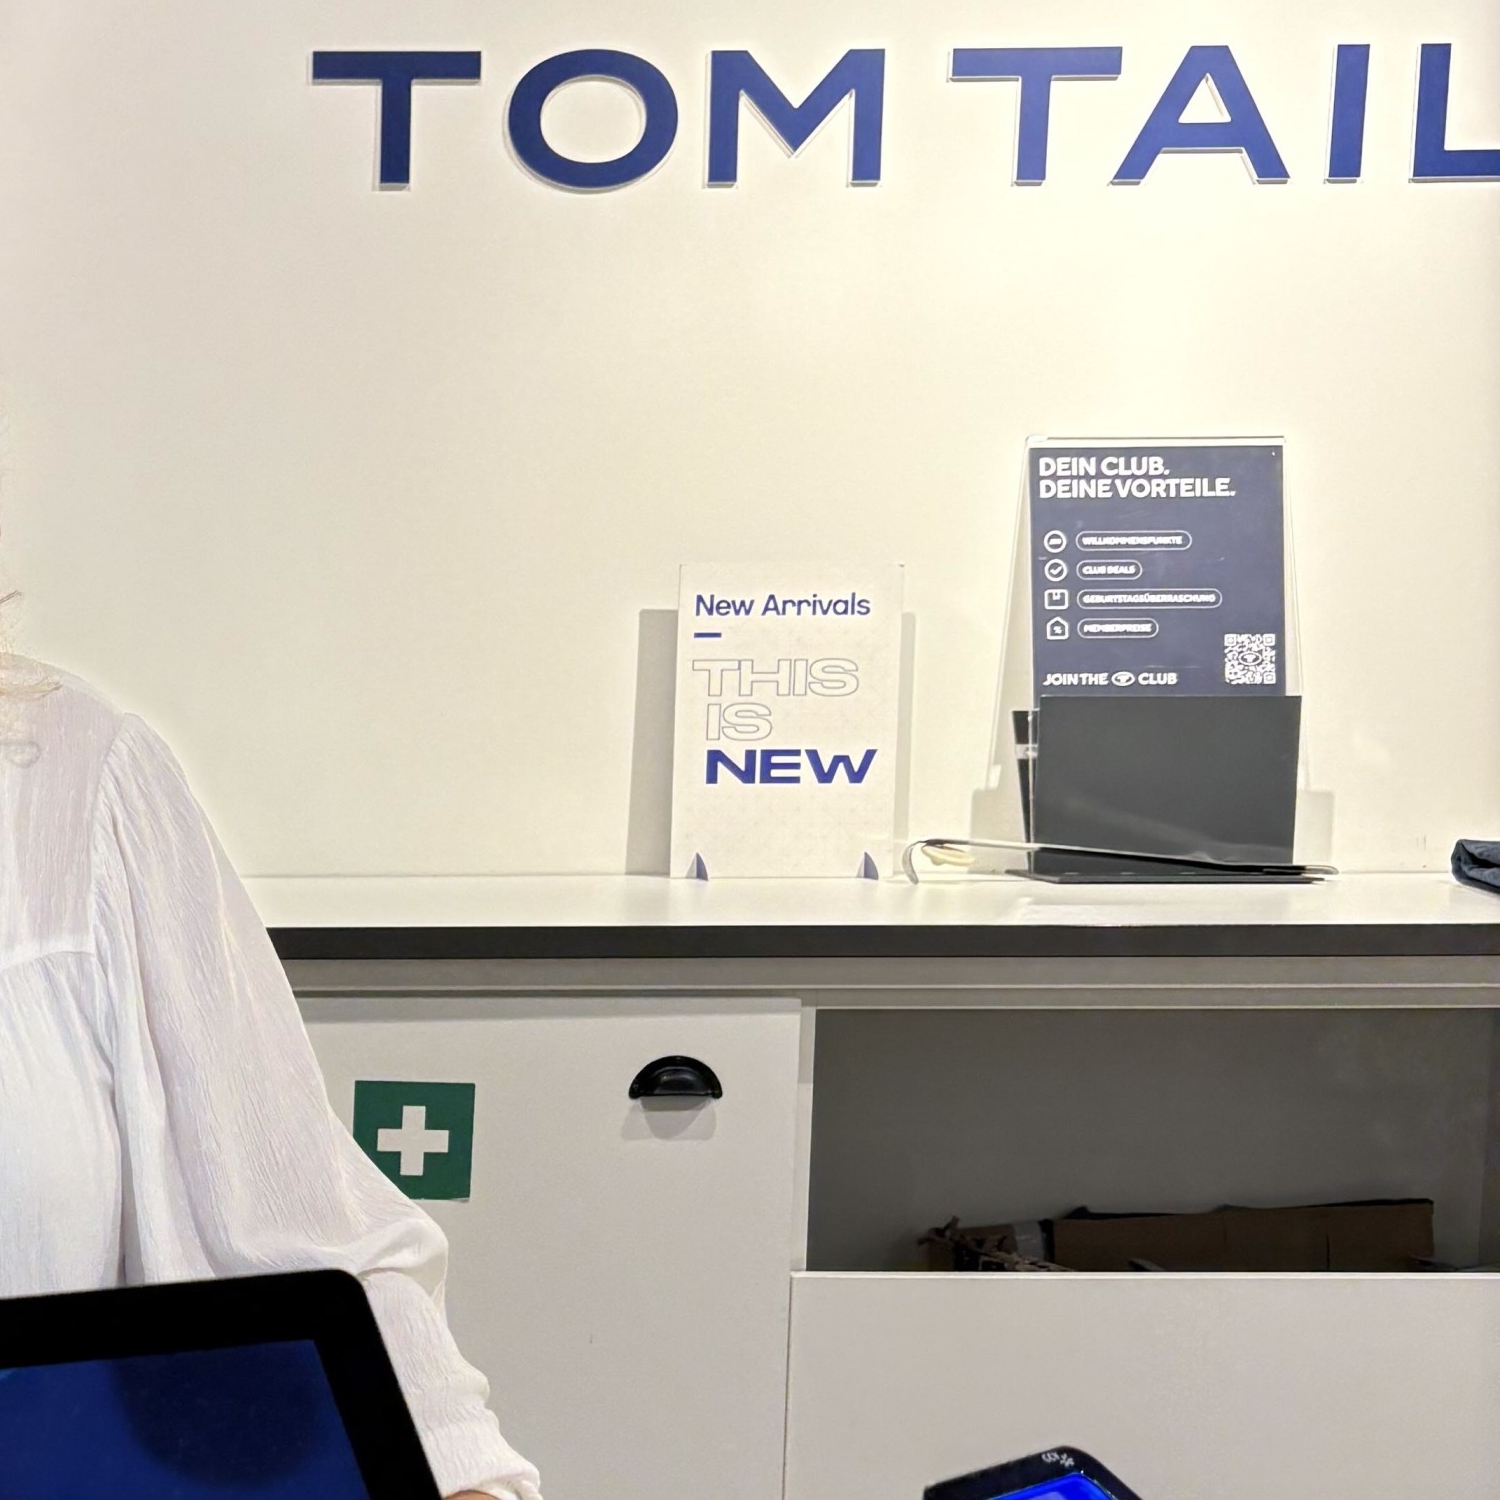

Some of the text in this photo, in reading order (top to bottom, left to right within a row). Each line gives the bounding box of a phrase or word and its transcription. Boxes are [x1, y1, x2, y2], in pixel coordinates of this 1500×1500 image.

[311, 42, 1500, 190] TOM TAIL
[1038, 456, 1171, 477] DEIN CLUB.
[1038, 477, 1237, 499] DEINE VORTEILE.
[694, 592, 871, 617] New Arrivals
[691, 657, 860, 697] THIS
[1042, 672, 1178, 686] JOIN THE CLUB
[705, 702, 773, 741] IS
[705, 748, 879, 784] NEW
